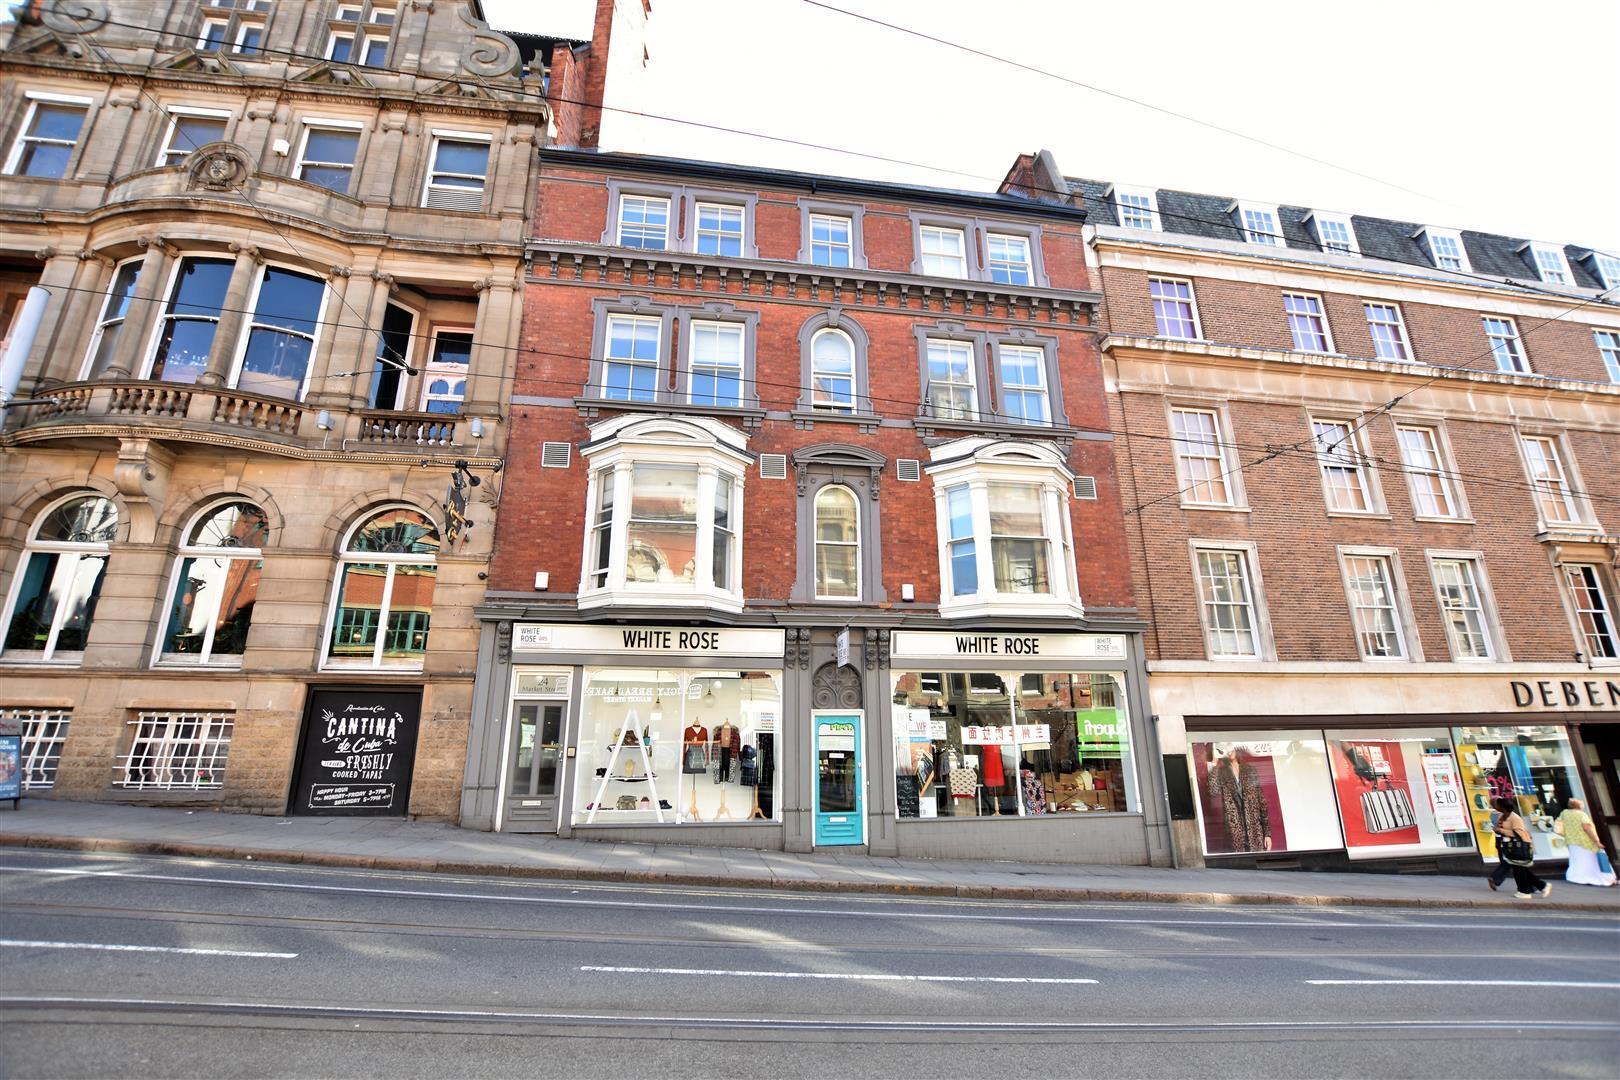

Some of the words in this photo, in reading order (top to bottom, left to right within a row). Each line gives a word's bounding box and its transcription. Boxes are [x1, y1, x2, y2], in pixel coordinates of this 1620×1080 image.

[521, 627, 540, 635] WHITE
[623, 630, 671, 648] WHITE
[679, 631, 719, 649] ROSE
[955, 636, 998, 653] WHITE
[1004, 638, 1040, 654] ROSE
[327, 717, 396, 739] CANTINA
[337, 738, 352, 752] de
[352, 737, 383, 753] Cuba
[346, 753, 394, 772] FRESHLY
[361, 771, 383, 779] TAPAS
[316, 788, 334, 796] HAPPY
[1435, 789, 1457, 804] £10
